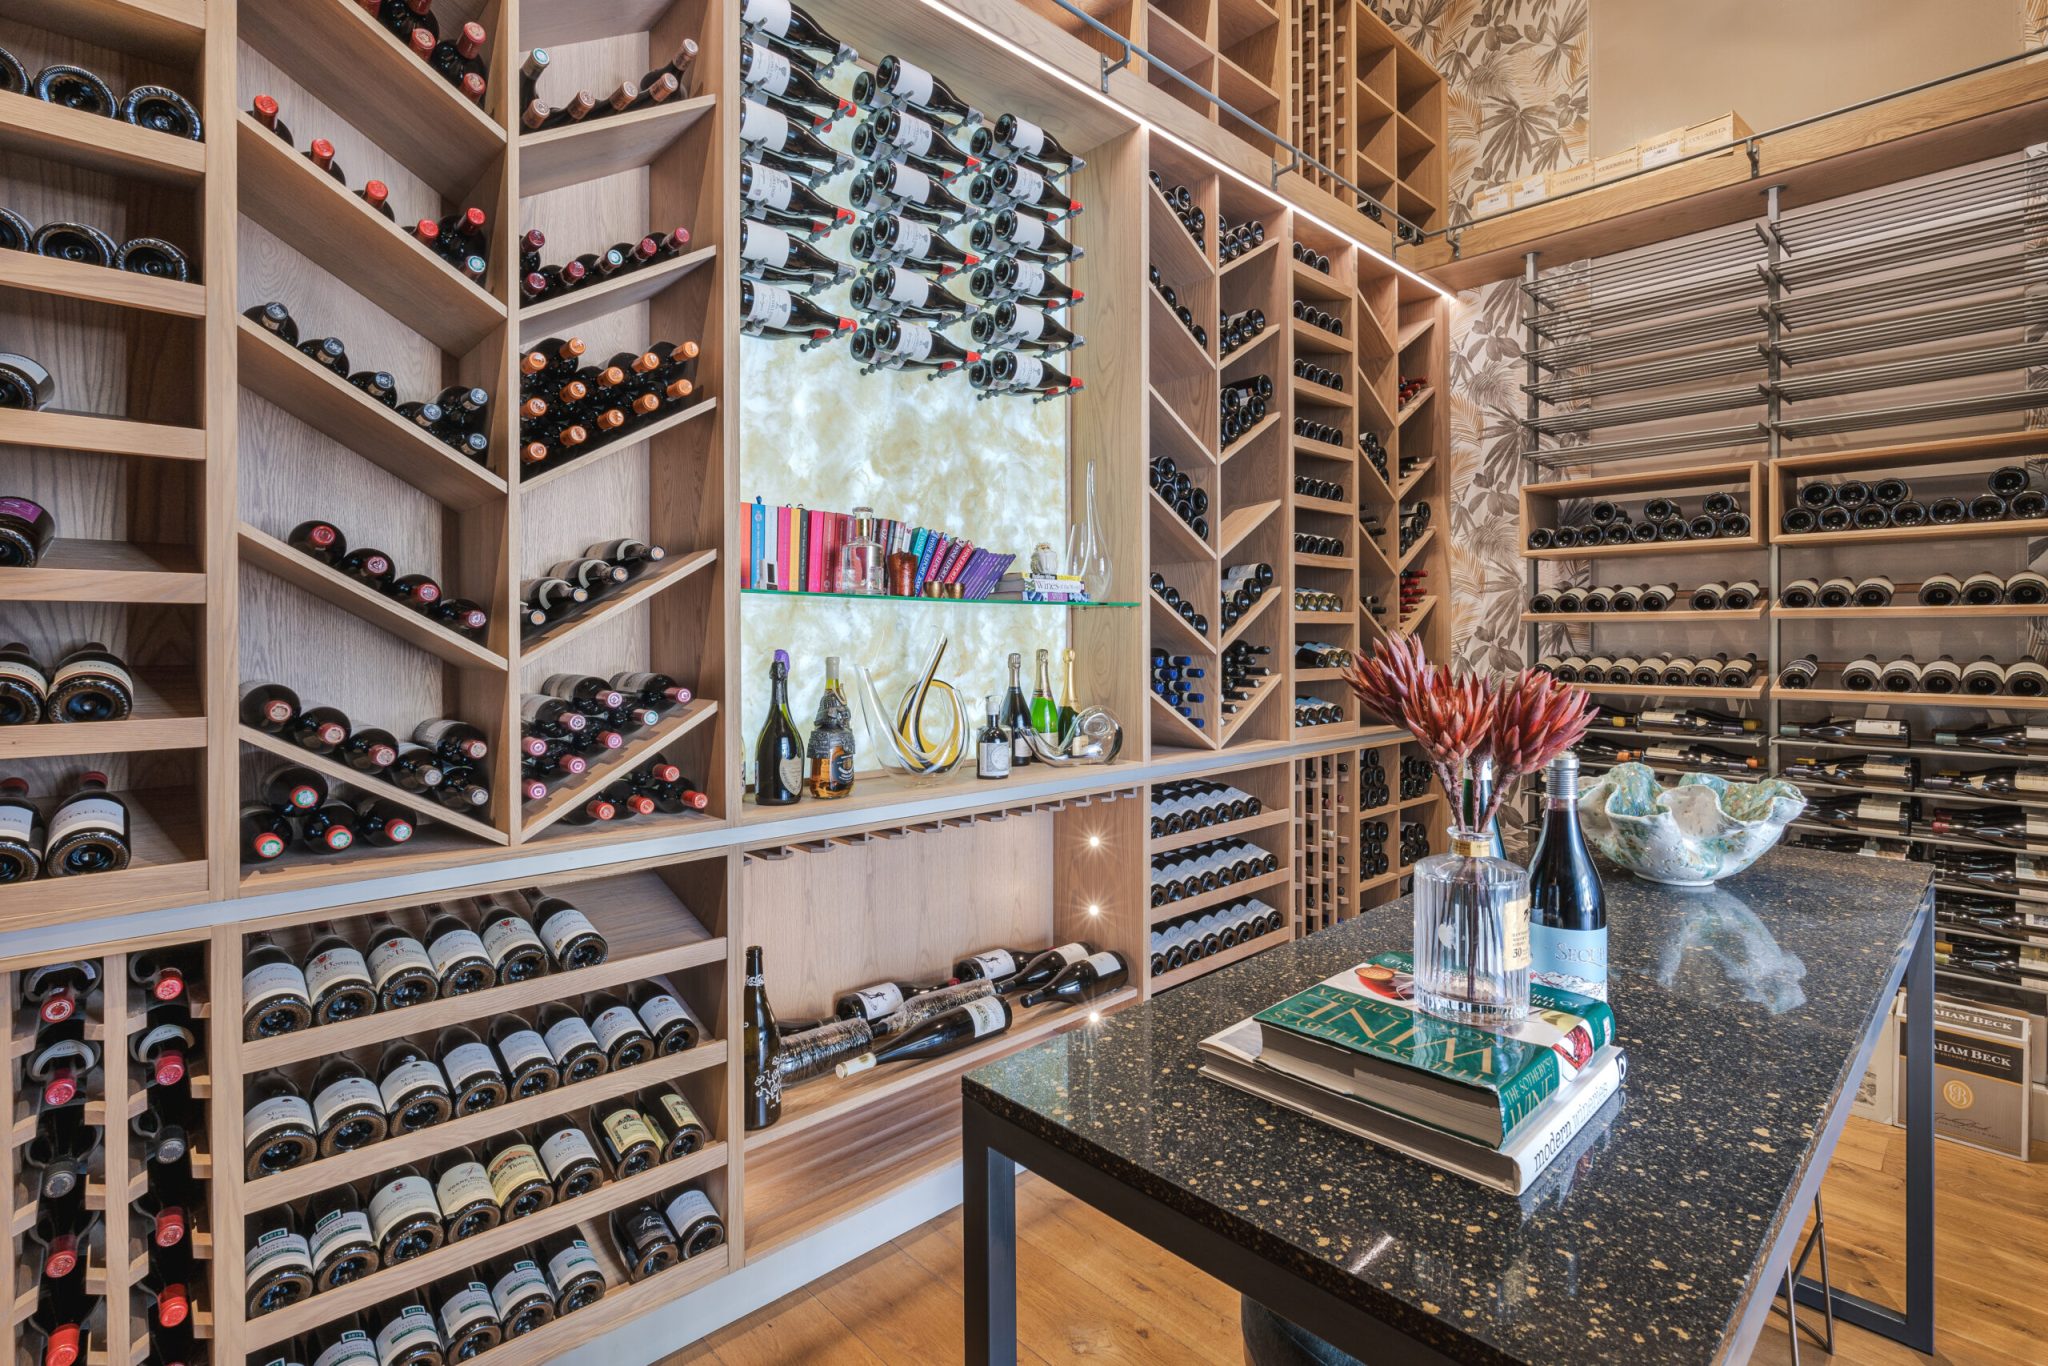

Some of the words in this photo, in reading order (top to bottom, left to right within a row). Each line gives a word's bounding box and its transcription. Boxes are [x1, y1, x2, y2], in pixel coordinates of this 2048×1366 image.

[927, 533, 939, 554] WINE
[937, 540, 948, 560] WINE
[950, 544, 960, 561] WINE
[961, 545, 971, 562] WINE
[919, 553, 932, 580] REPORT
[1036, 580, 1060, 591] Wines
[1934, 1008, 1970, 1021] AHAM
[1973, 1016, 2012, 1031] BECK
[1266, 1008, 1411, 1061] SOTHEBY'S
[1283, 993, 1493, 1075] WINE
[1934, 1043, 1969, 1057] AHAM
[1971, 1050, 2012, 1067] BECK
[1432, 1061, 1485, 1082] THE
[1504, 1088, 1520, 1105] THE
[1509, 1073, 1553, 1129] WINE
[1534, 1120, 1573, 1173] modern
